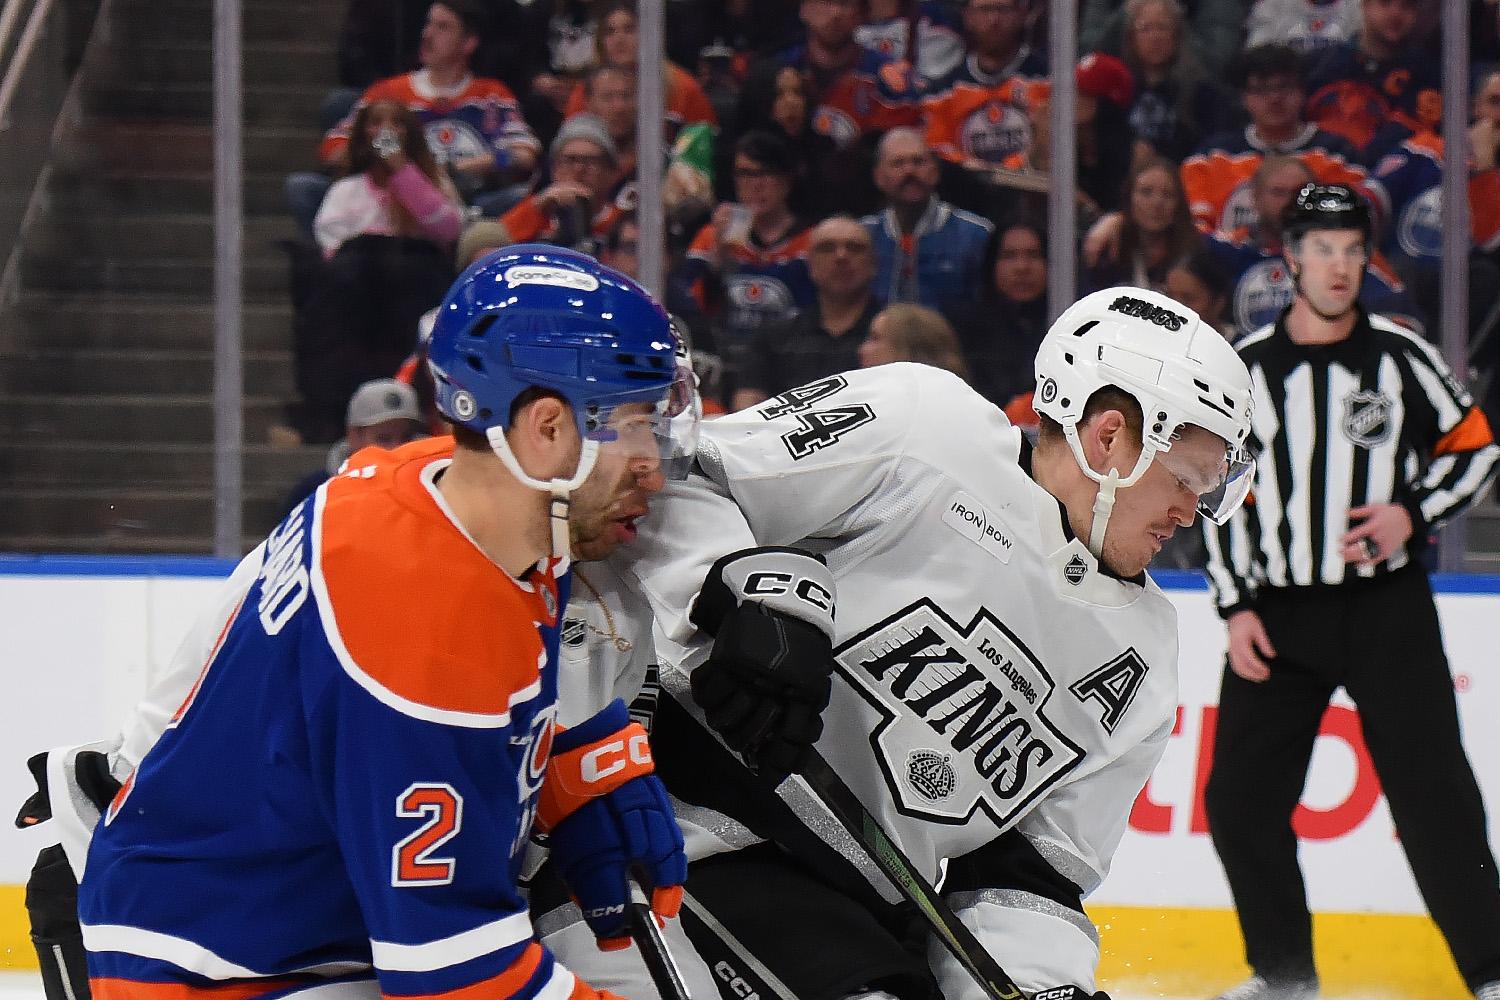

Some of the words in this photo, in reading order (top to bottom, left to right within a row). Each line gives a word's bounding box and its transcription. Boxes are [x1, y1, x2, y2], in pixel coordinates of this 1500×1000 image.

[1108, 295, 1189, 333] KINGS
[757, 375, 877, 461] 44
[950, 501, 984, 528] IRON
[986, 526, 1012, 550] BOW
[743, 572, 836, 620] CC
[976, 637, 1003, 665] Los
[999, 658, 1039, 706] Angeles
[1068, 646, 1149, 736] A
[859, 625, 1054, 799] KINGS
[391, 783, 463, 887] 2
